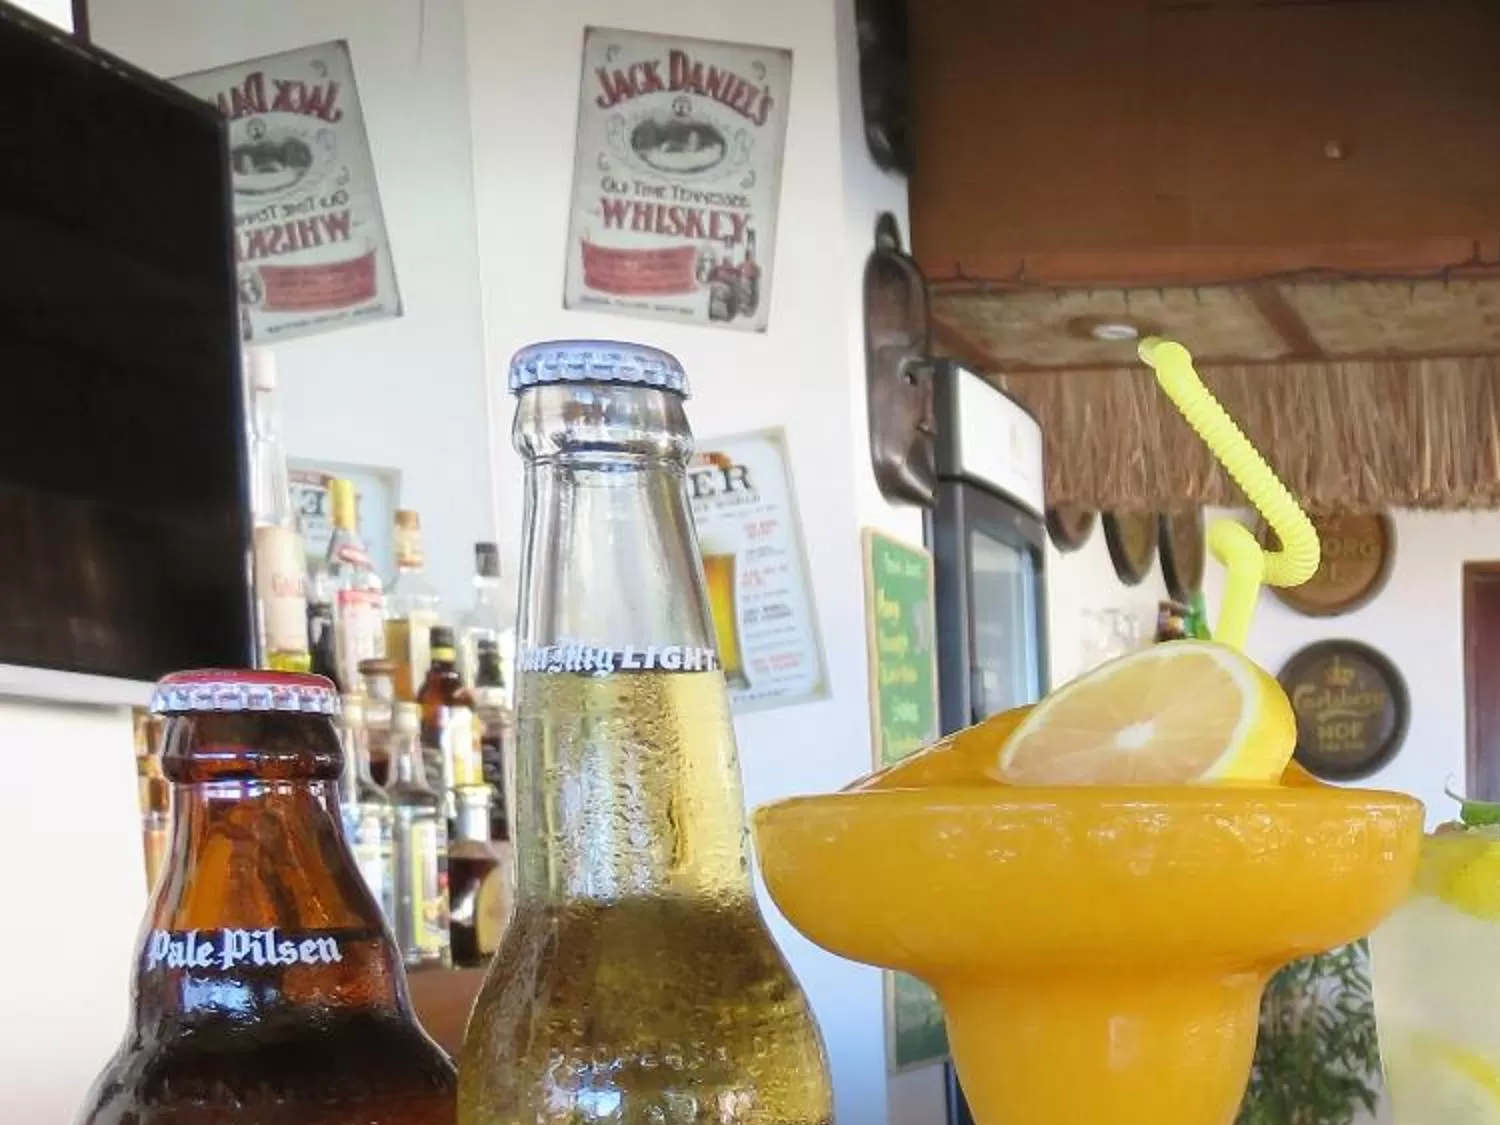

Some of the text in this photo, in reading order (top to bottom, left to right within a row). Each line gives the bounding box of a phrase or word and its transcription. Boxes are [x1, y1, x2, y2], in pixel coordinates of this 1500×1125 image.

[593, 48, 775, 127] JACK DANIEL'S
[600, 197, 751, 244] WHISKEY
[620, 644, 717, 672] LIGHT
[148, 928, 343, 970] Pale Pilsen
